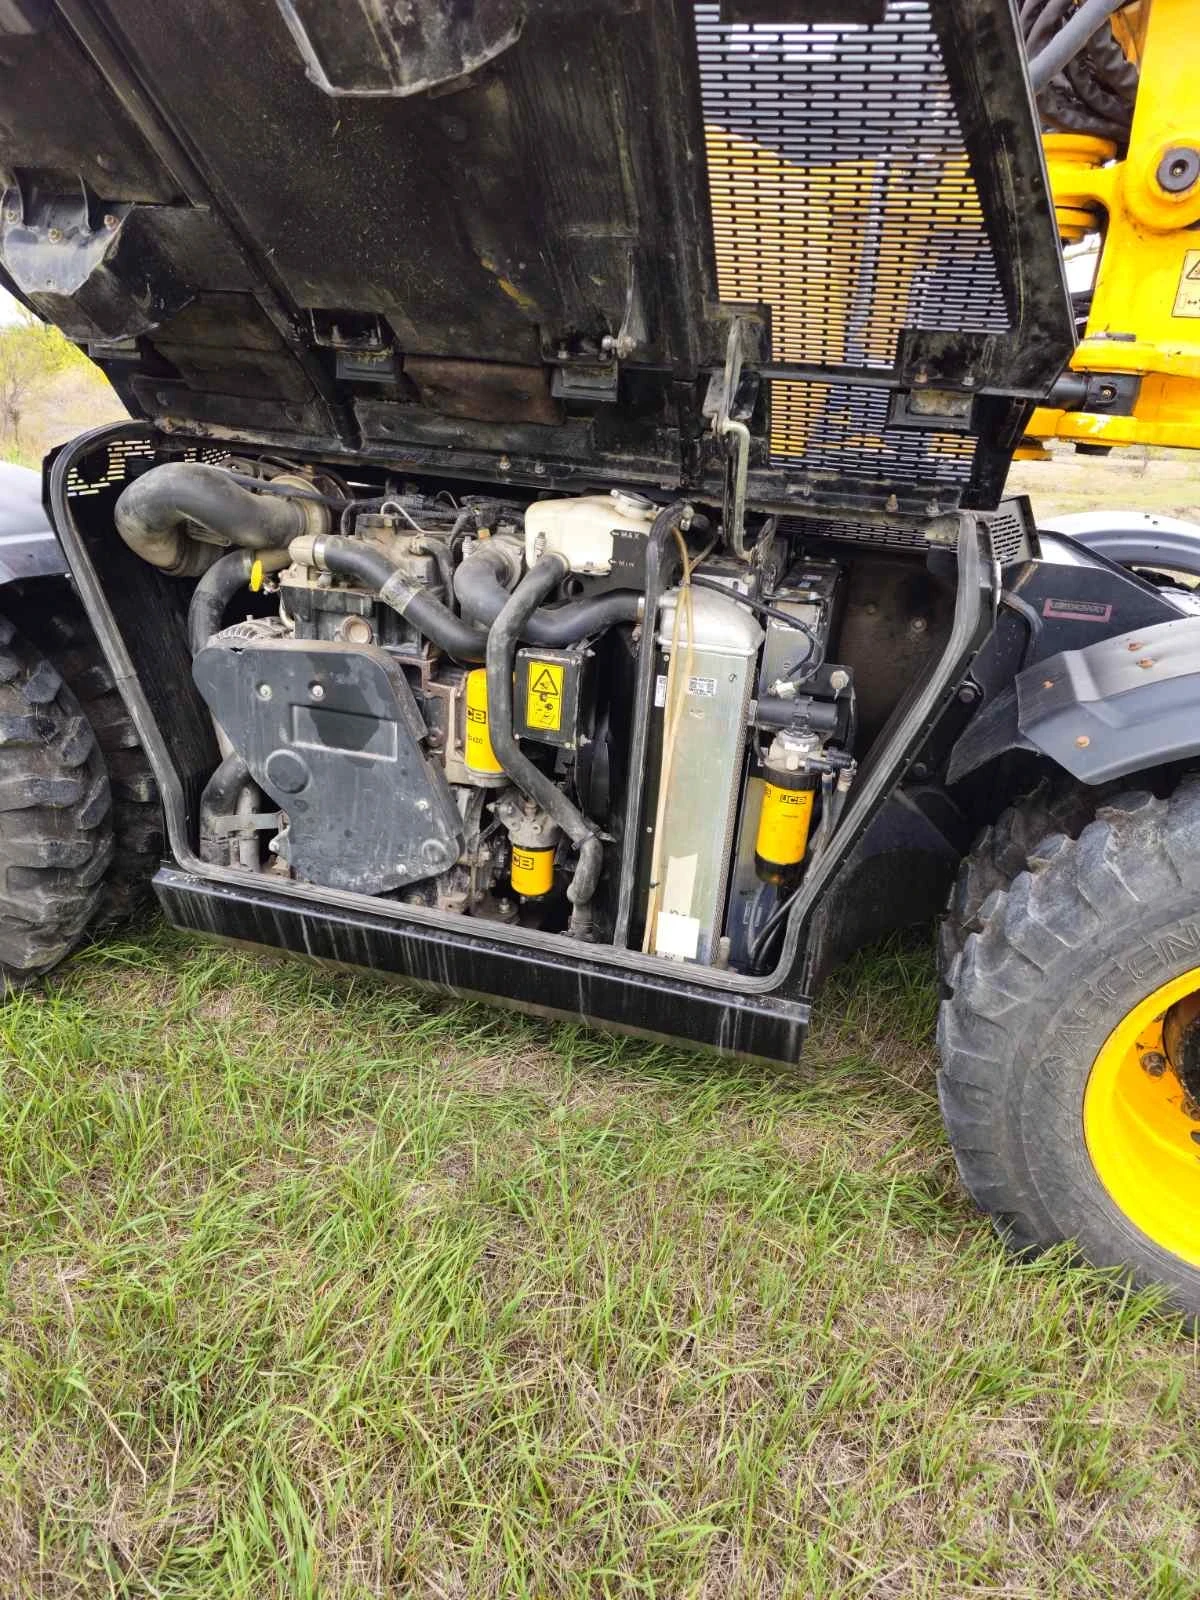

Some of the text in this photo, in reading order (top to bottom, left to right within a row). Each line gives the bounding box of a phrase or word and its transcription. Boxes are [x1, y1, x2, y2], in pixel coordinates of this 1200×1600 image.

[467, 706, 486, 724] CB
[780, 794, 807, 804] JCB
[513, 853, 534, 870] CB
